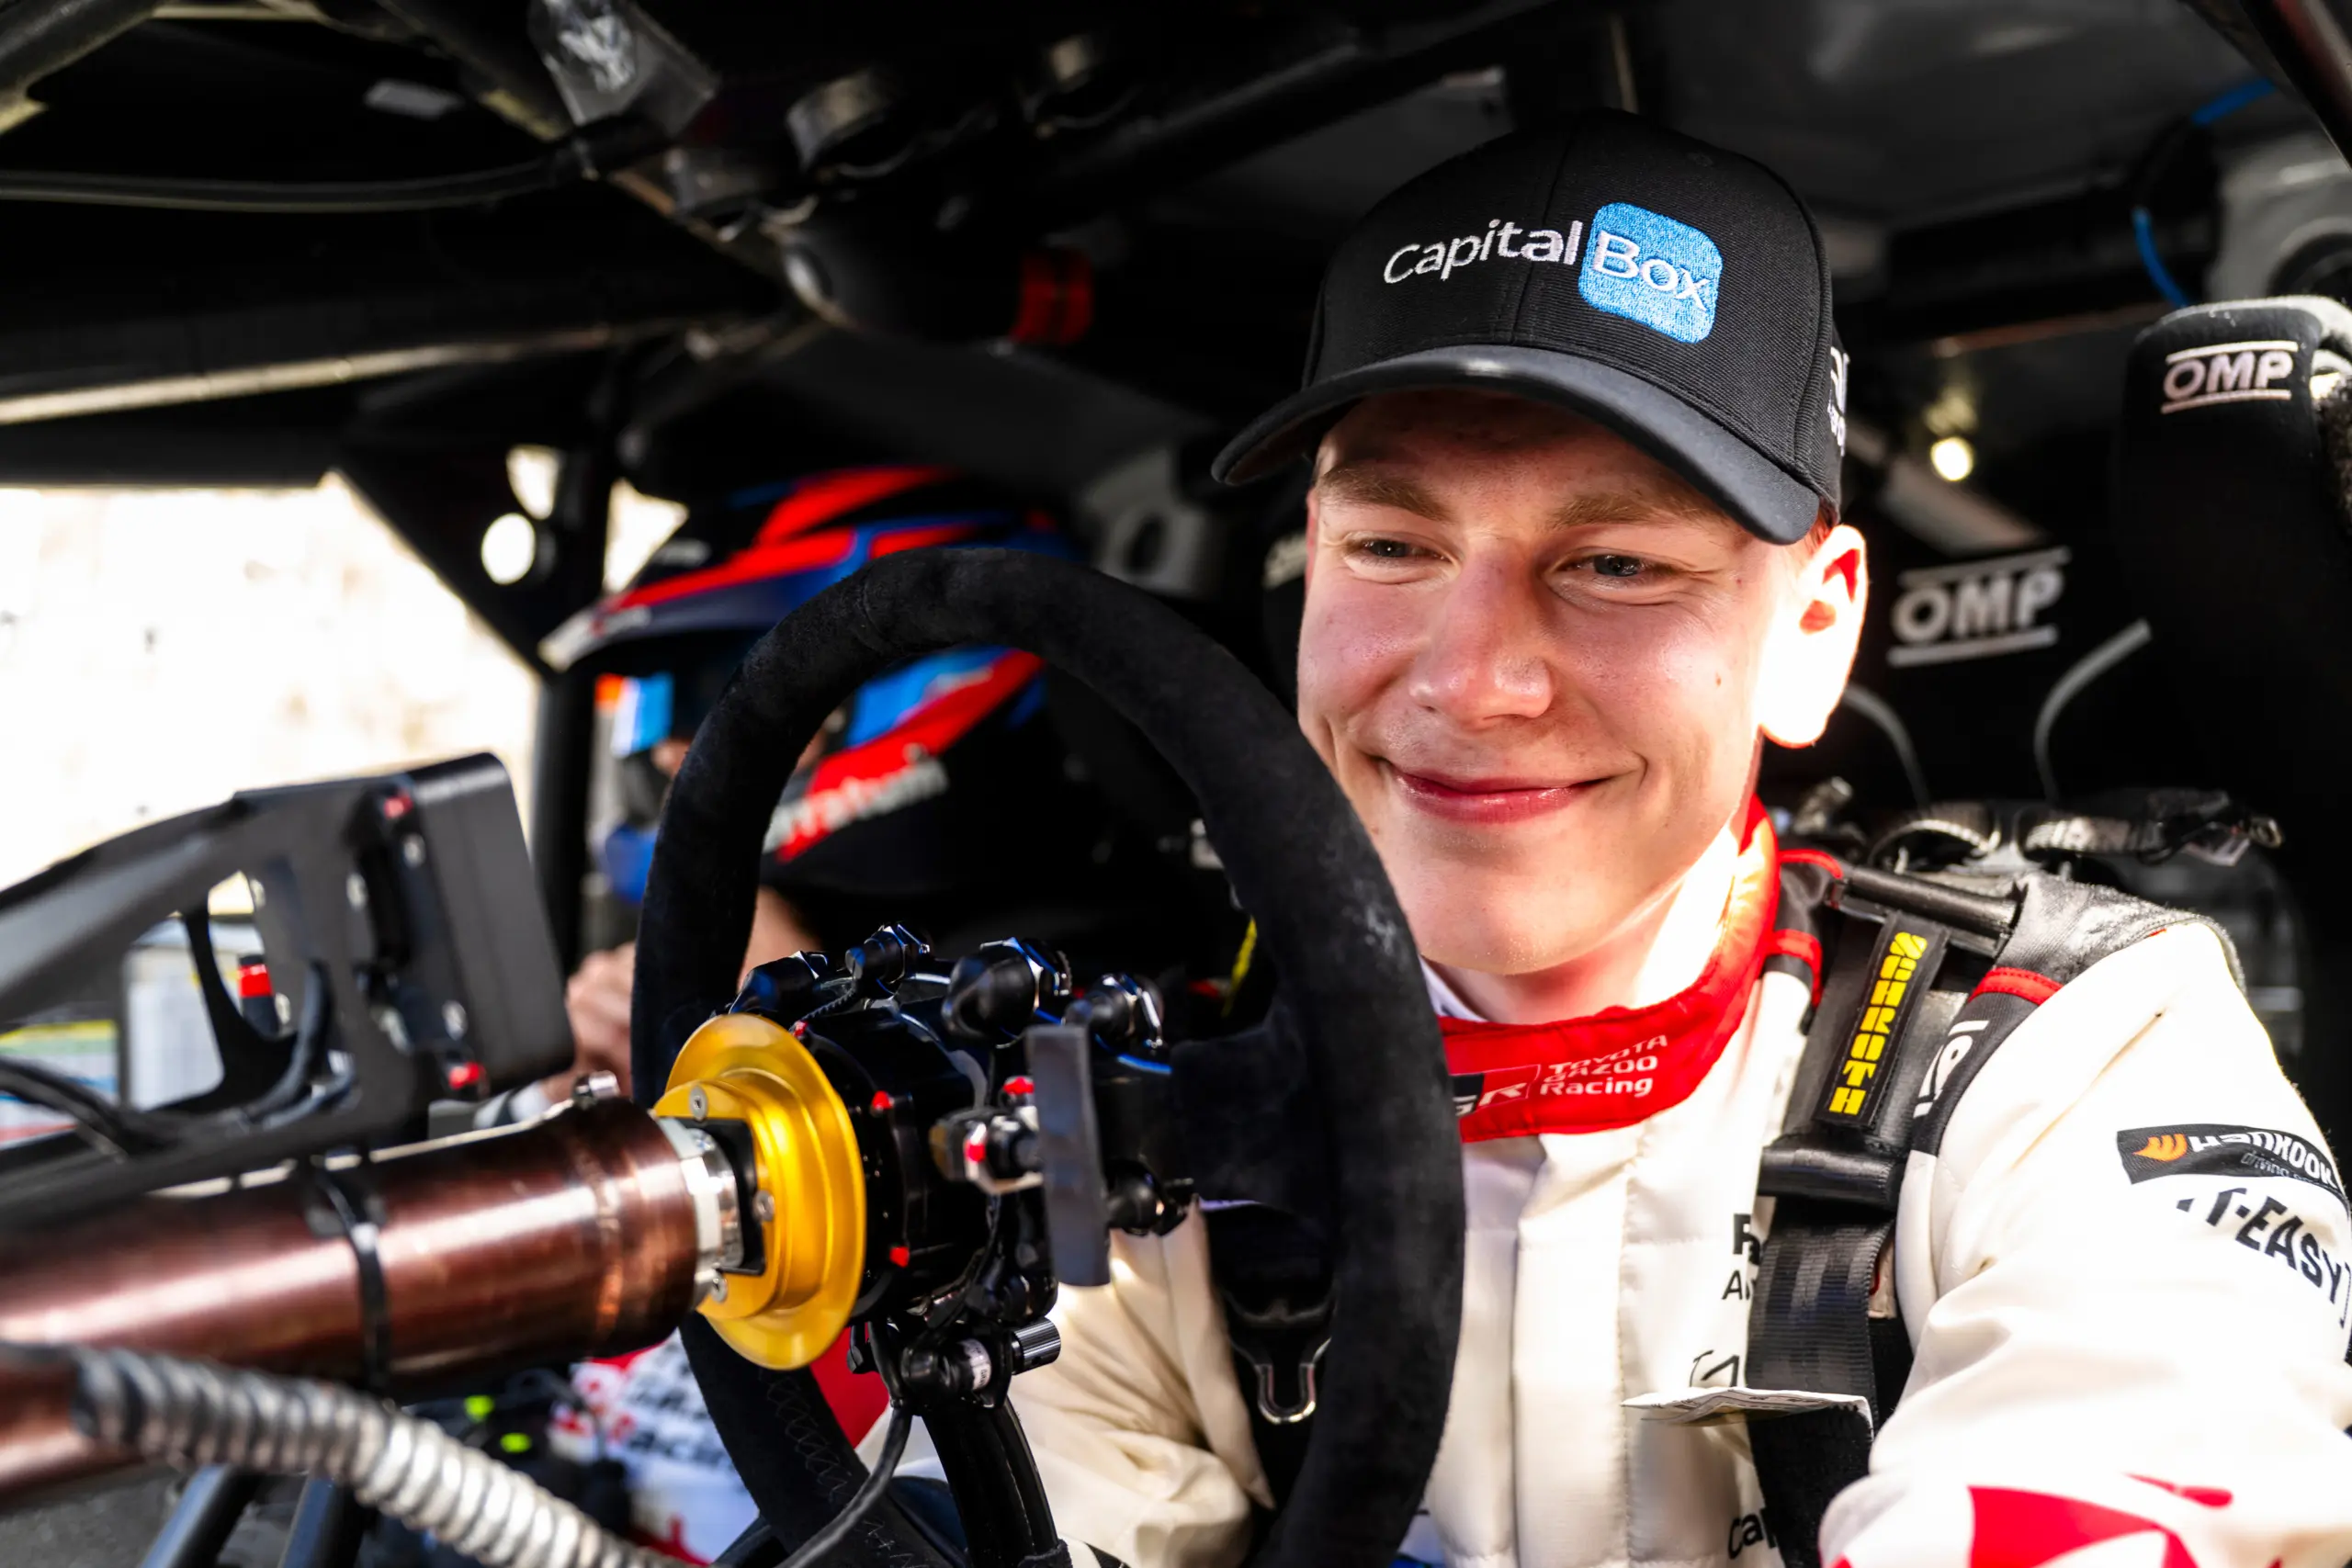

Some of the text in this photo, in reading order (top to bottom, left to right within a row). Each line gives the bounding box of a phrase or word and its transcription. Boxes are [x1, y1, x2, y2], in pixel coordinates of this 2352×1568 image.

[1590, 229, 1712, 311] Box
[2162, 349, 2293, 400] OMP
[1891, 564, 2064, 643] OMP
[1548, 1034, 1668, 1075] TOYOTA
[1828, 931, 1928, 1115] SCHROTH
[1540, 1077, 1654, 1098] Racing
